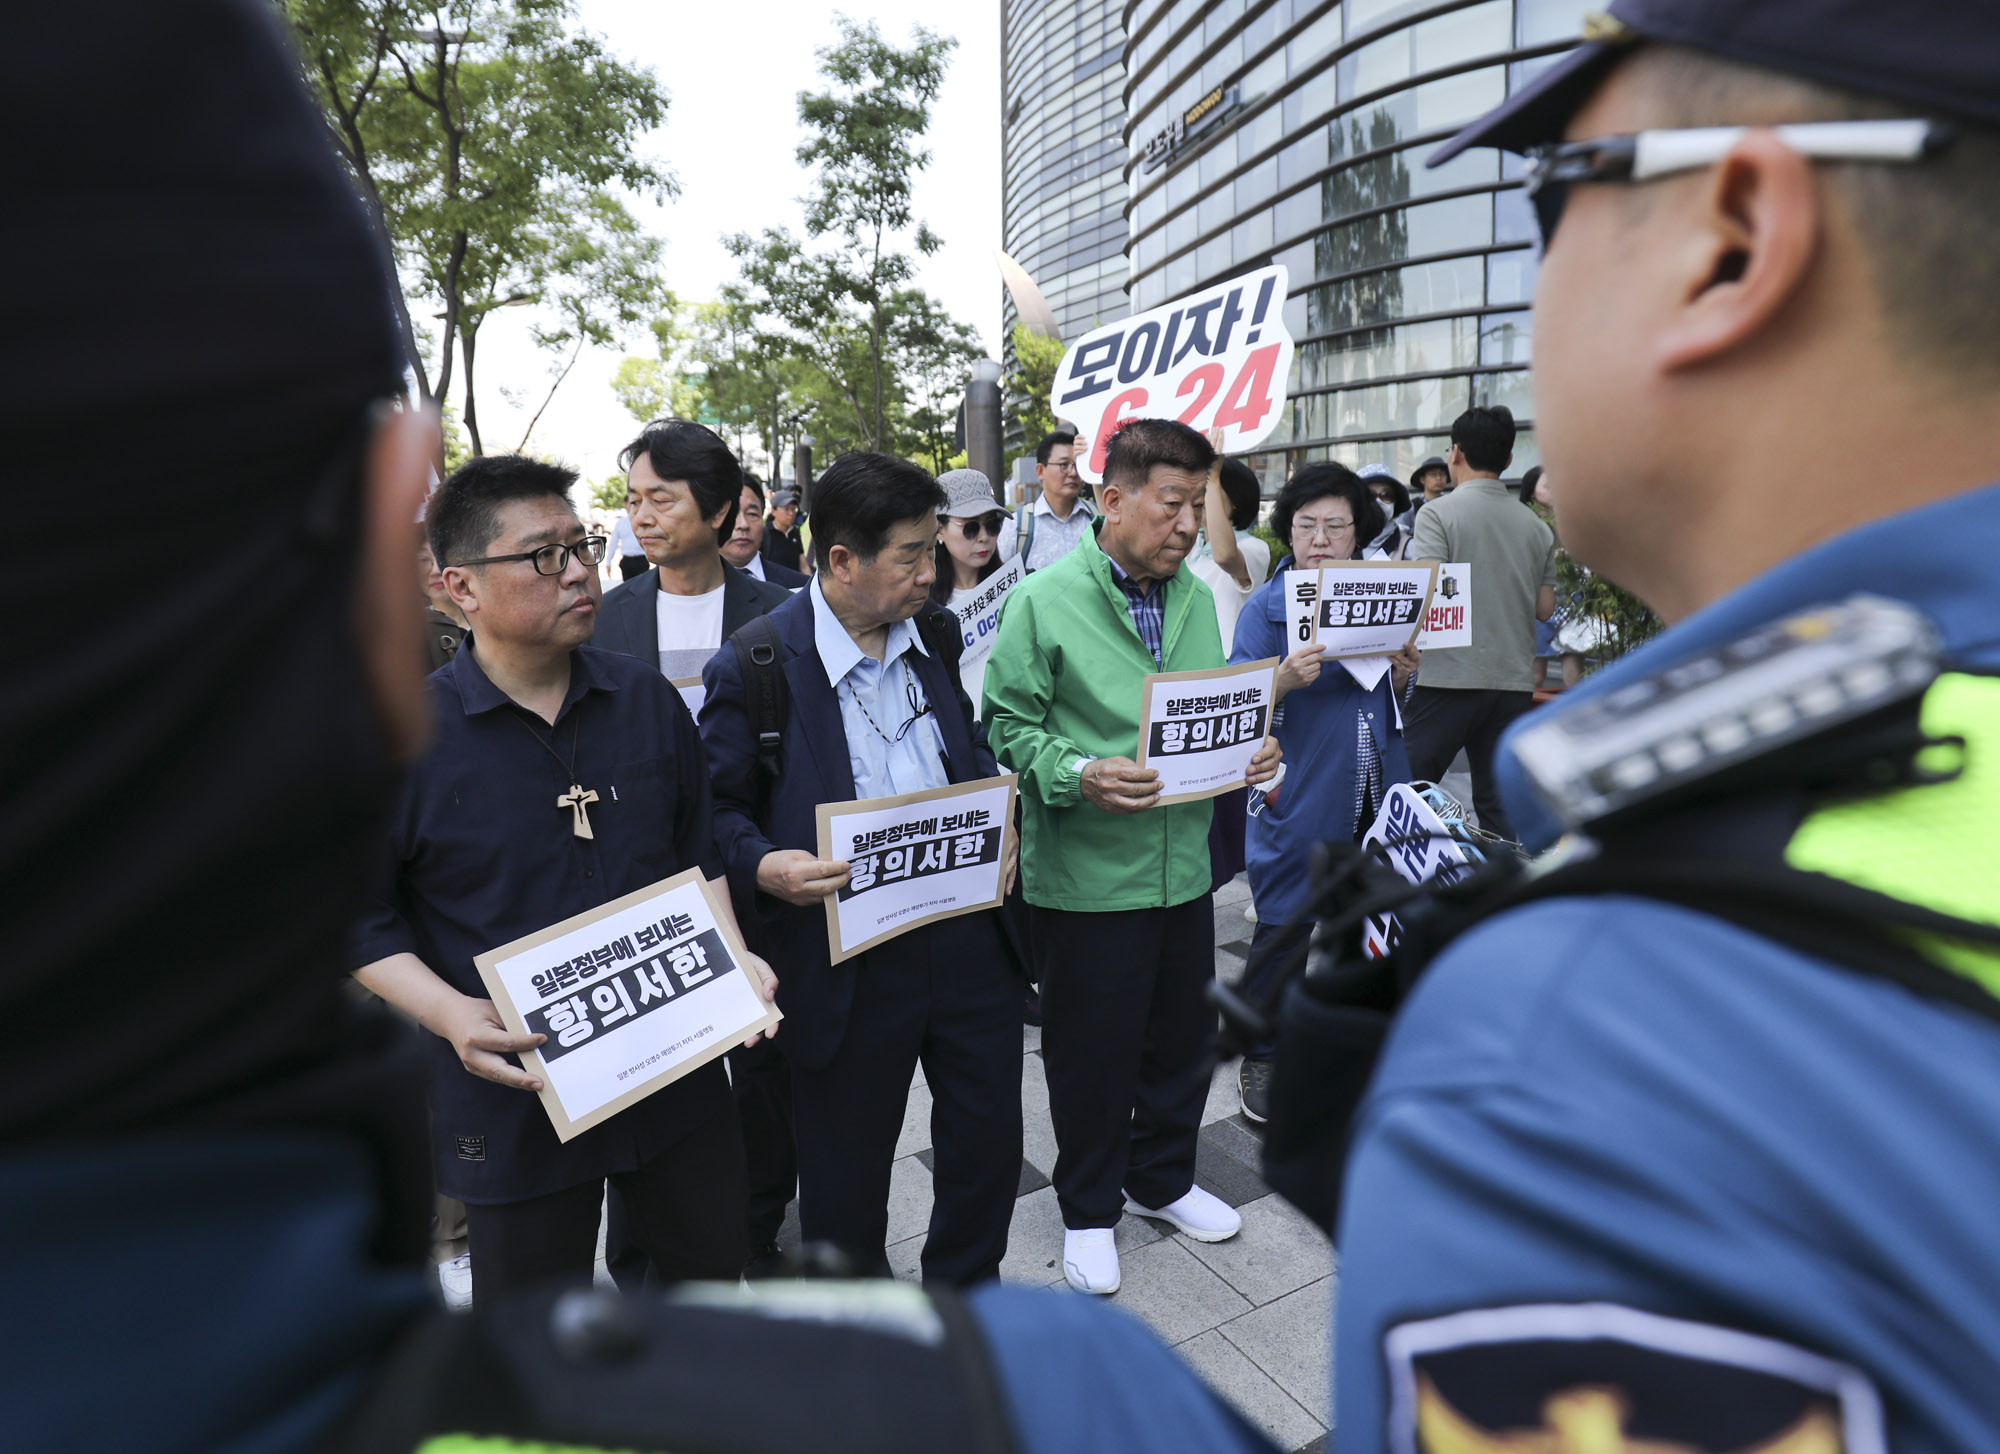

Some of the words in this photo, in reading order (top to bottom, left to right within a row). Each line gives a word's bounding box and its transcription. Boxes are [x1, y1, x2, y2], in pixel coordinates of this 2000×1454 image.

[1060, 274, 1277, 405] 모이자!
[1333, 582, 1385, 596] 일본정부에
[1387, 581, 1418, 595] 보내는
[1328, 600, 1413, 626] 항의서한
[1166, 693, 1231, 716] 일본정부에
[1231, 687, 1262, 708] 보내는
[1161, 709, 1258, 753] 항의서한
[852, 818, 938, 854] 일본정부에
[940, 810, 990, 832] 보내는
[850, 833, 986, 892] 항의서한
[531, 935, 638, 999] 일본정부에
[634, 912, 695, 952] 보내는
[543, 940, 714, 1048] 항의서한
[616, 1070, 629, 1081] 일본
[628, 1061, 646, 1074] 방사성
[645, 1053, 661, 1066] 오염수
[661, 1042, 683, 1057] 해양투기
